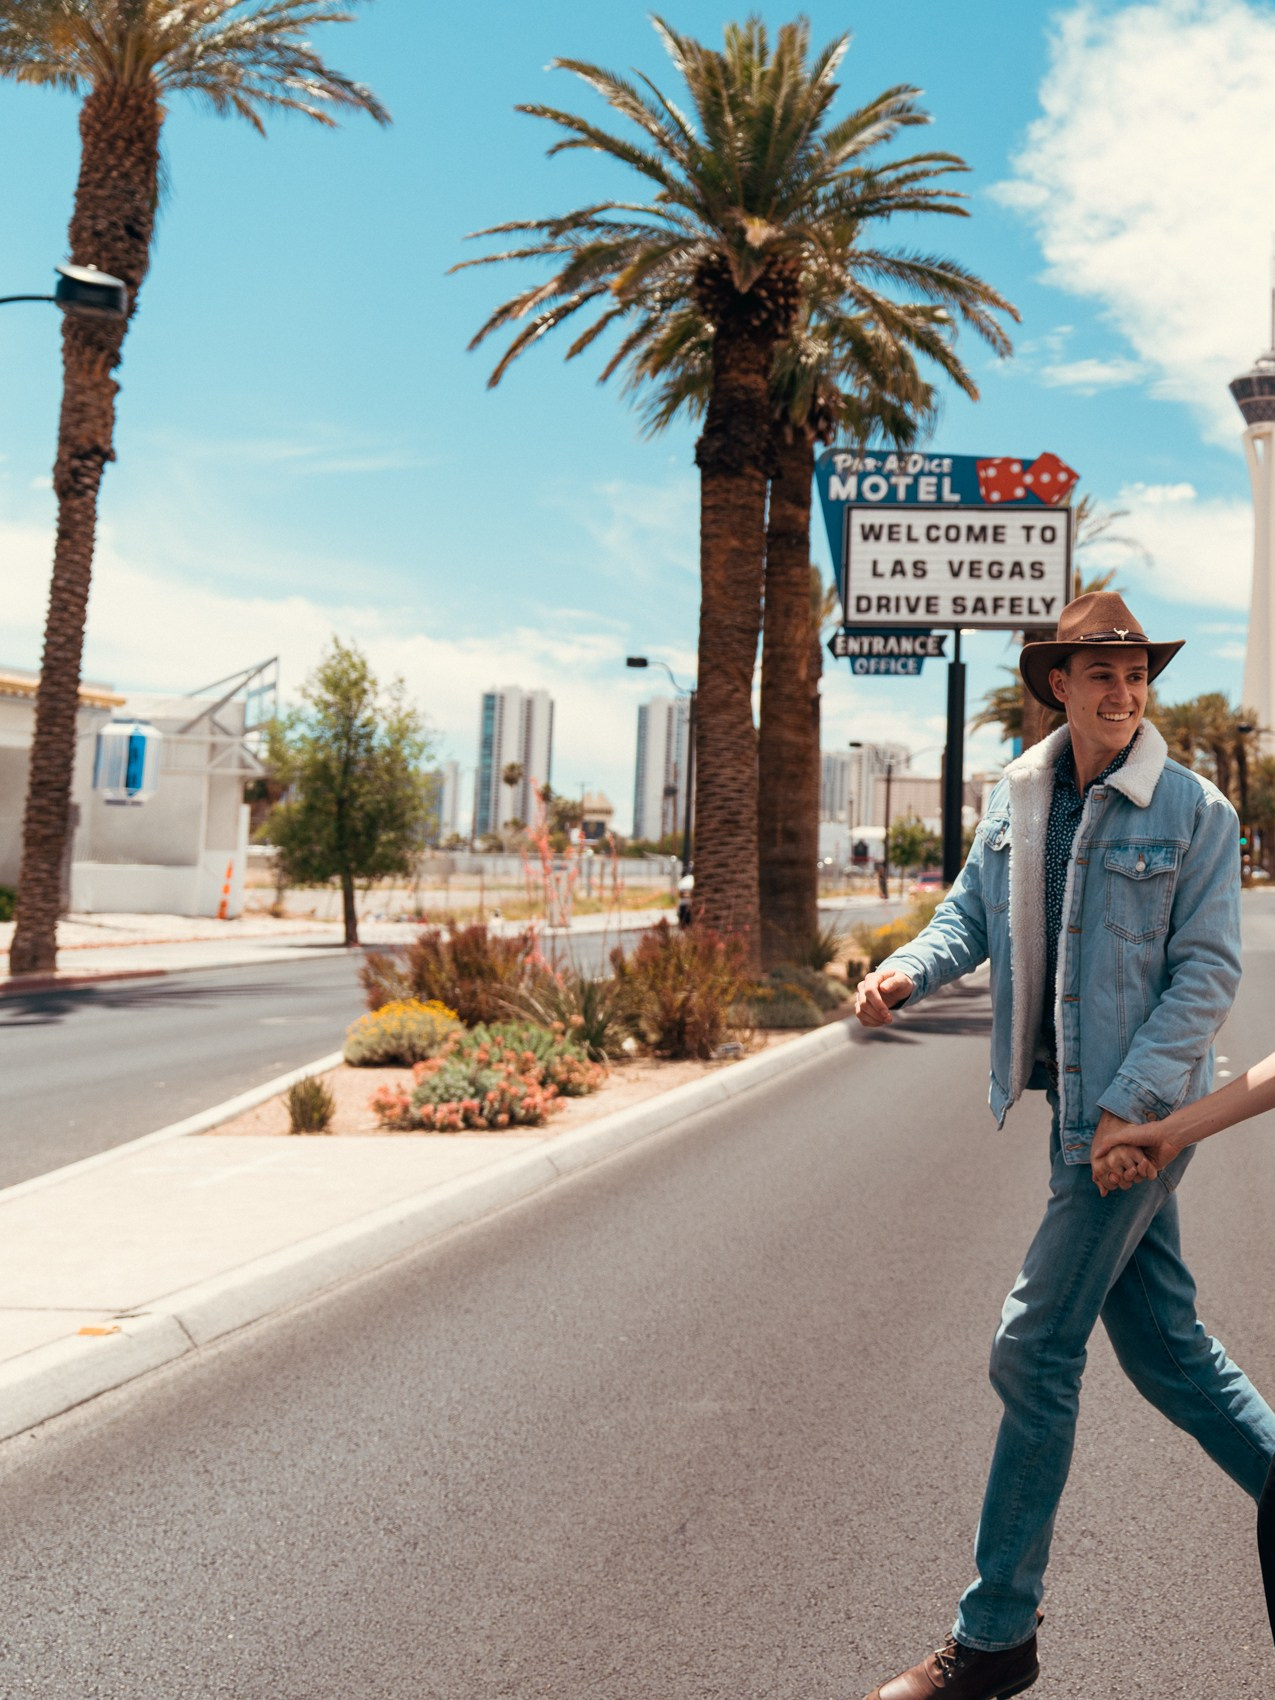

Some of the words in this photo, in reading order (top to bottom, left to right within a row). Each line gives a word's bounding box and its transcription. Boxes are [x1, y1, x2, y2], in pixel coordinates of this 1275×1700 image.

[828, 474, 961, 502] MOTEL
[860, 523, 1006, 543] WELCOME
[1022, 525, 1057, 543] TO
[871, 560, 928, 579] LAS
[948, 560, 1045, 579] VEGAS
[855, 595, 940, 615] DRIVE
[952, 597, 1056, 616] SAFELY
[835, 635, 939, 656] ENTRANCE
[854, 657, 918, 674] OFFICE
